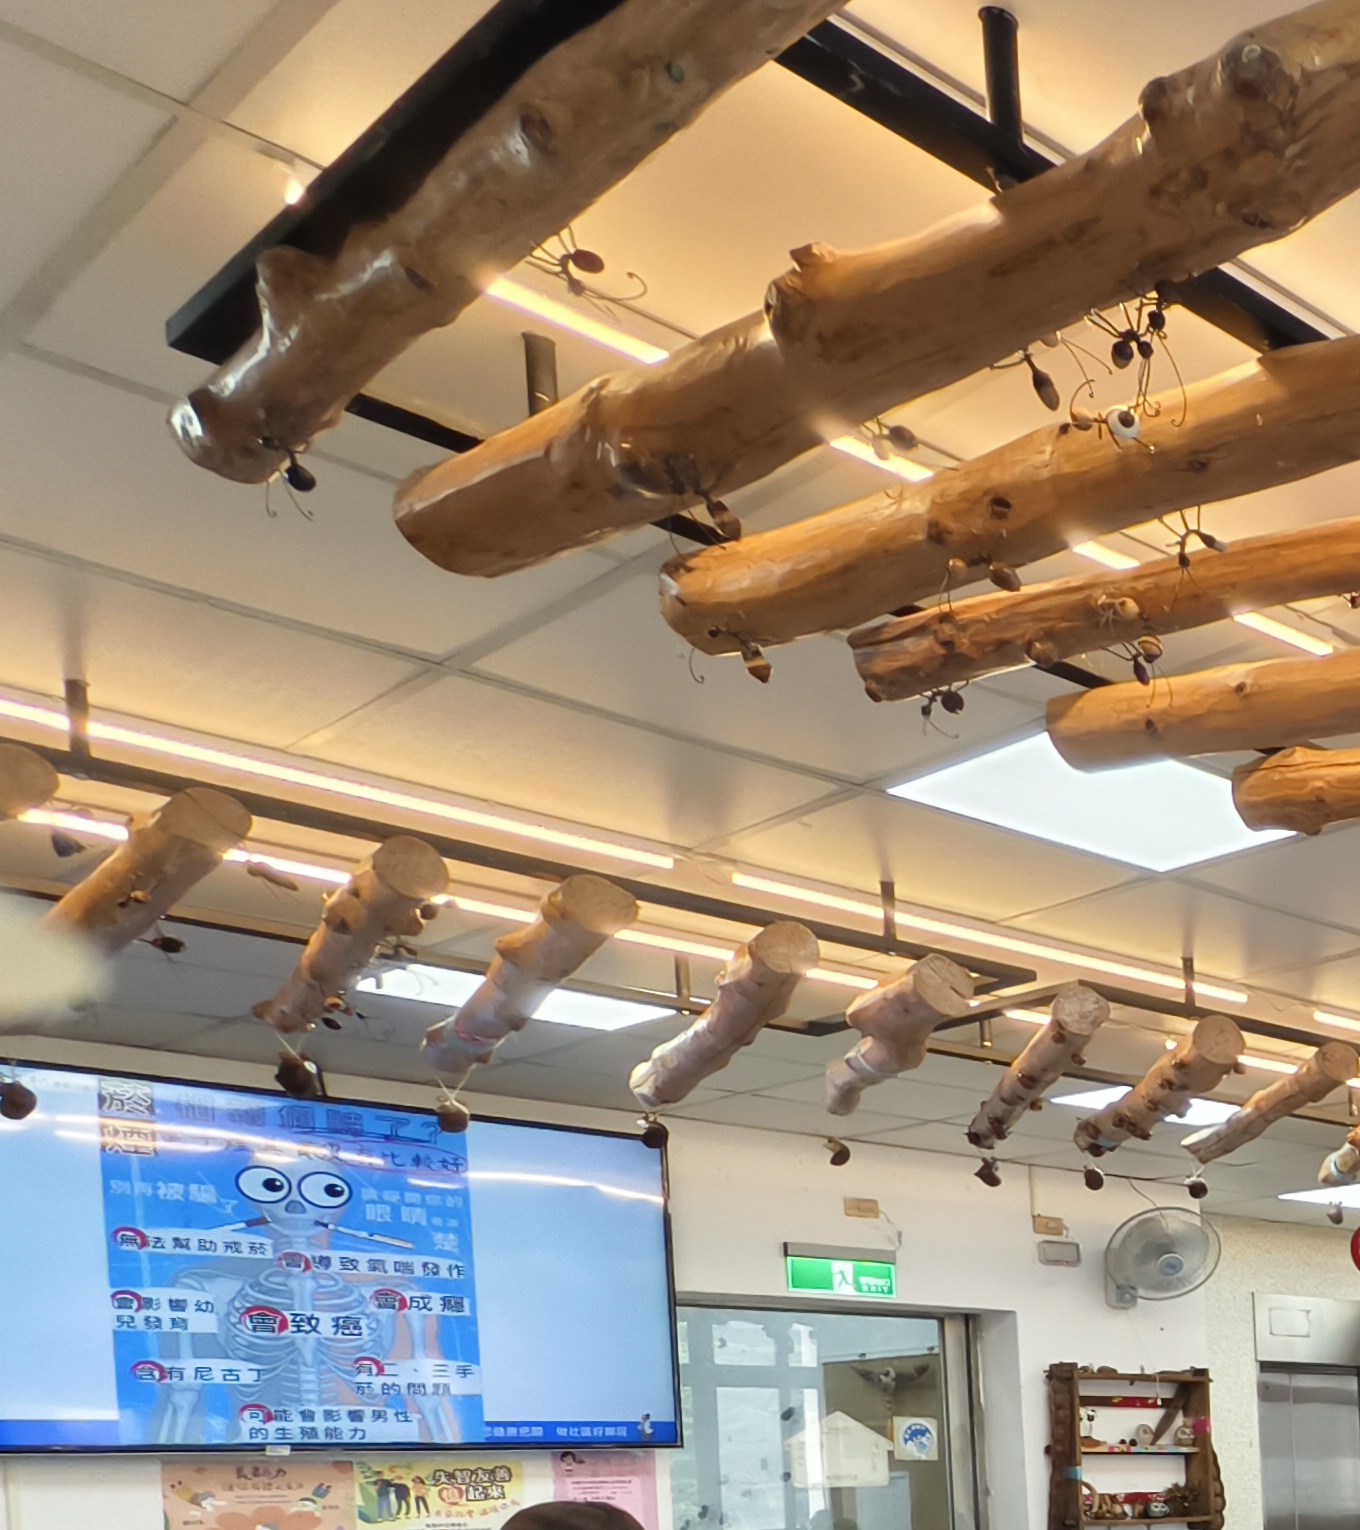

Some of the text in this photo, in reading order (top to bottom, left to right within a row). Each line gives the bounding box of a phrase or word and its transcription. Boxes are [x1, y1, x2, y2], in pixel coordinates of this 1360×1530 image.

[249, 1311, 364, 1338] 會致癌
[135, 1365, 268, 1383] 含有尼古丁
[248, 1407, 414, 1424] 可能會影響男性
[249, 1426, 367, 1441] 的生殖能力
